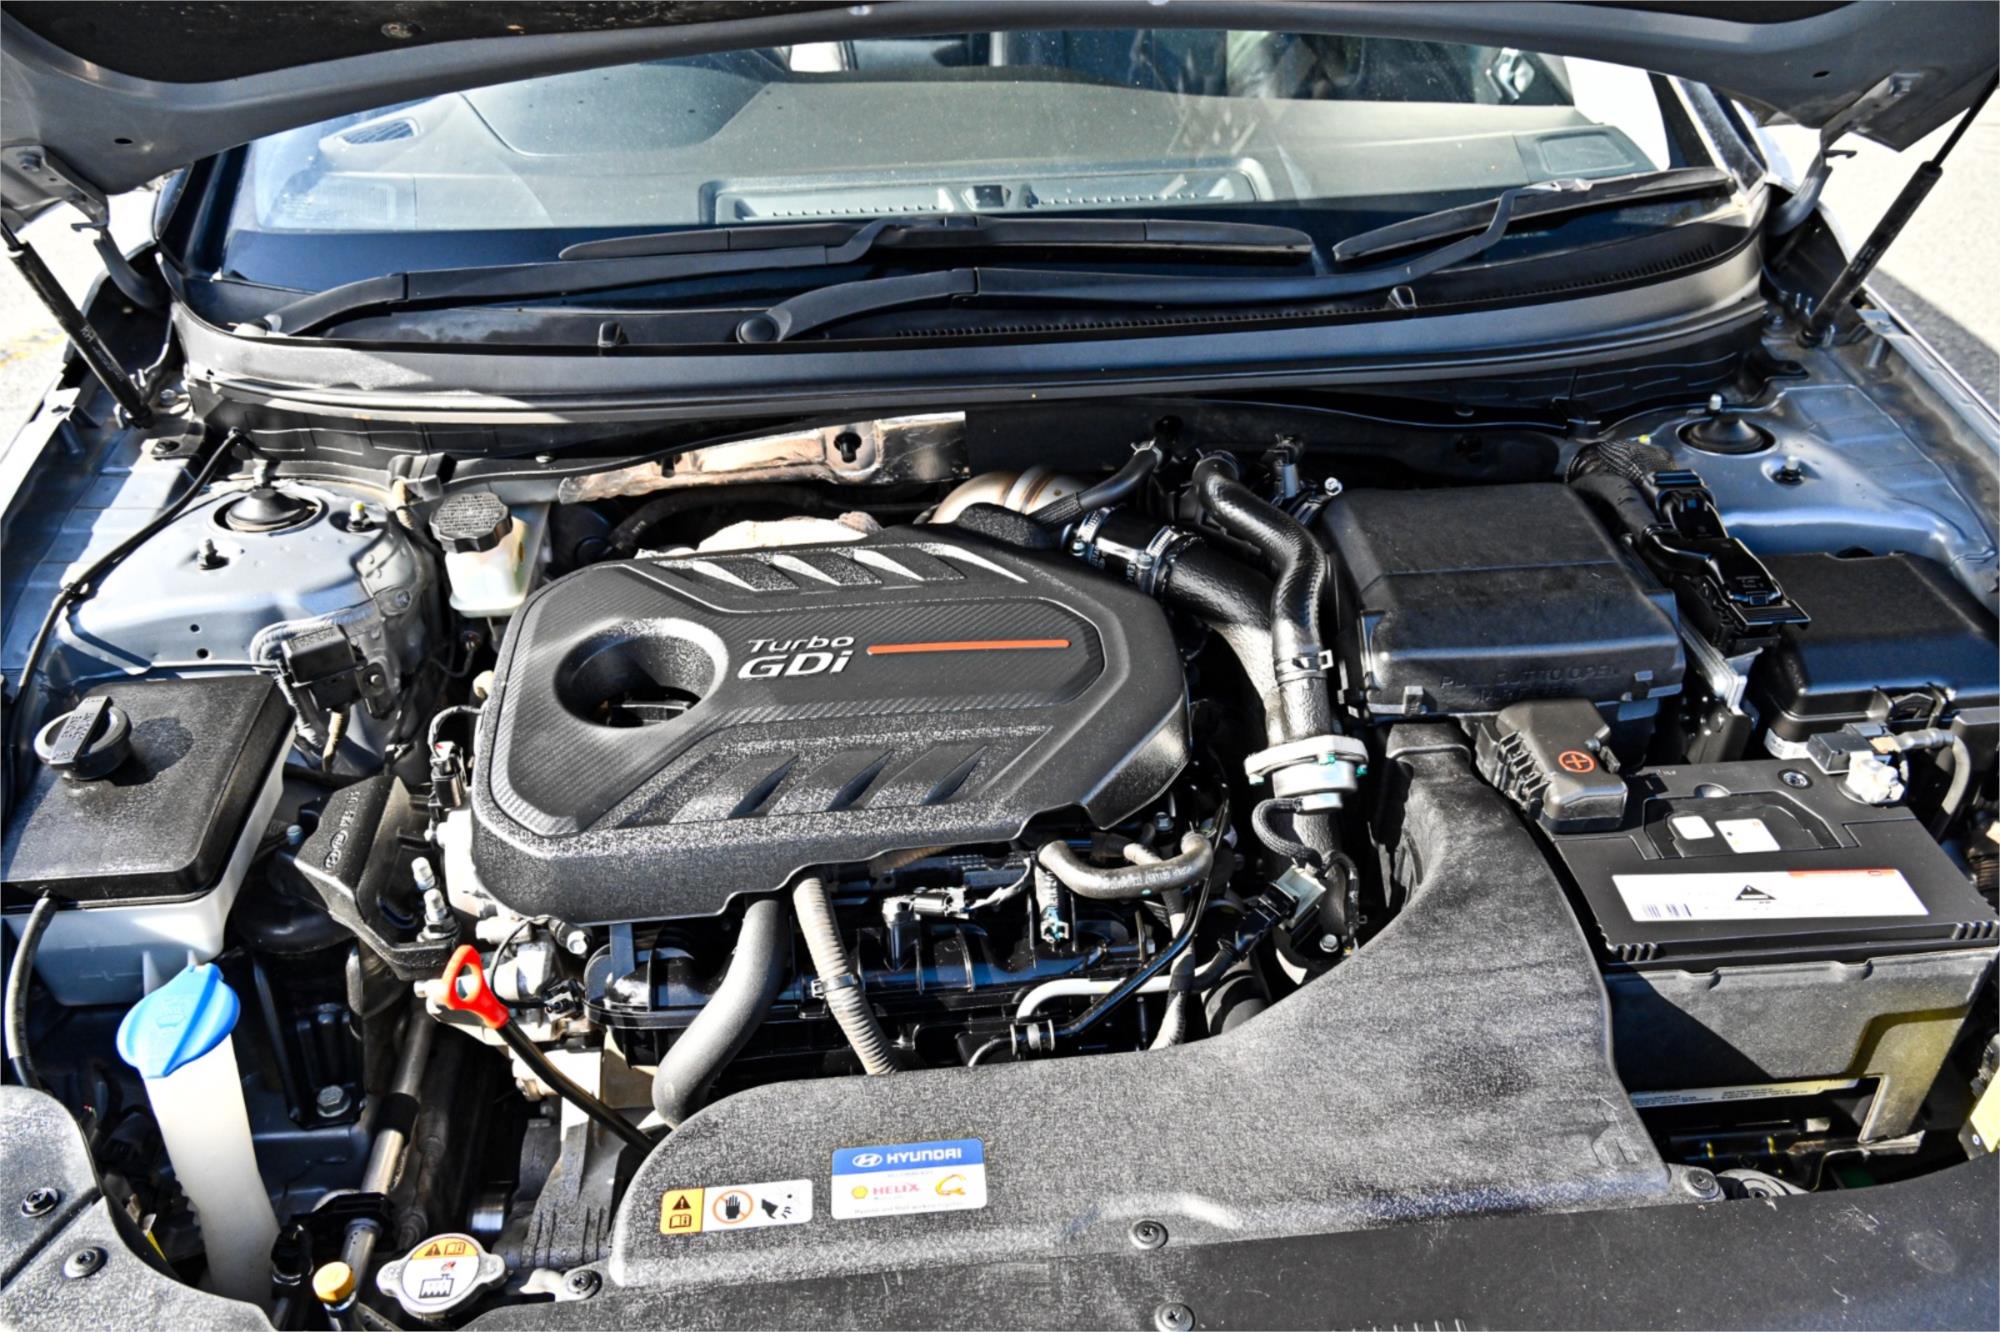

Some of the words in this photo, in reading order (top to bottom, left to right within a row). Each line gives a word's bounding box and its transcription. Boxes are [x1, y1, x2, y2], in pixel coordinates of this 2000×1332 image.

[747, 635, 854, 653] Turbo
[737, 650, 854, 679] GDi
[886, 1148, 962, 1164] HYUNDAI
[873, 1182, 920, 1195] HELIX
